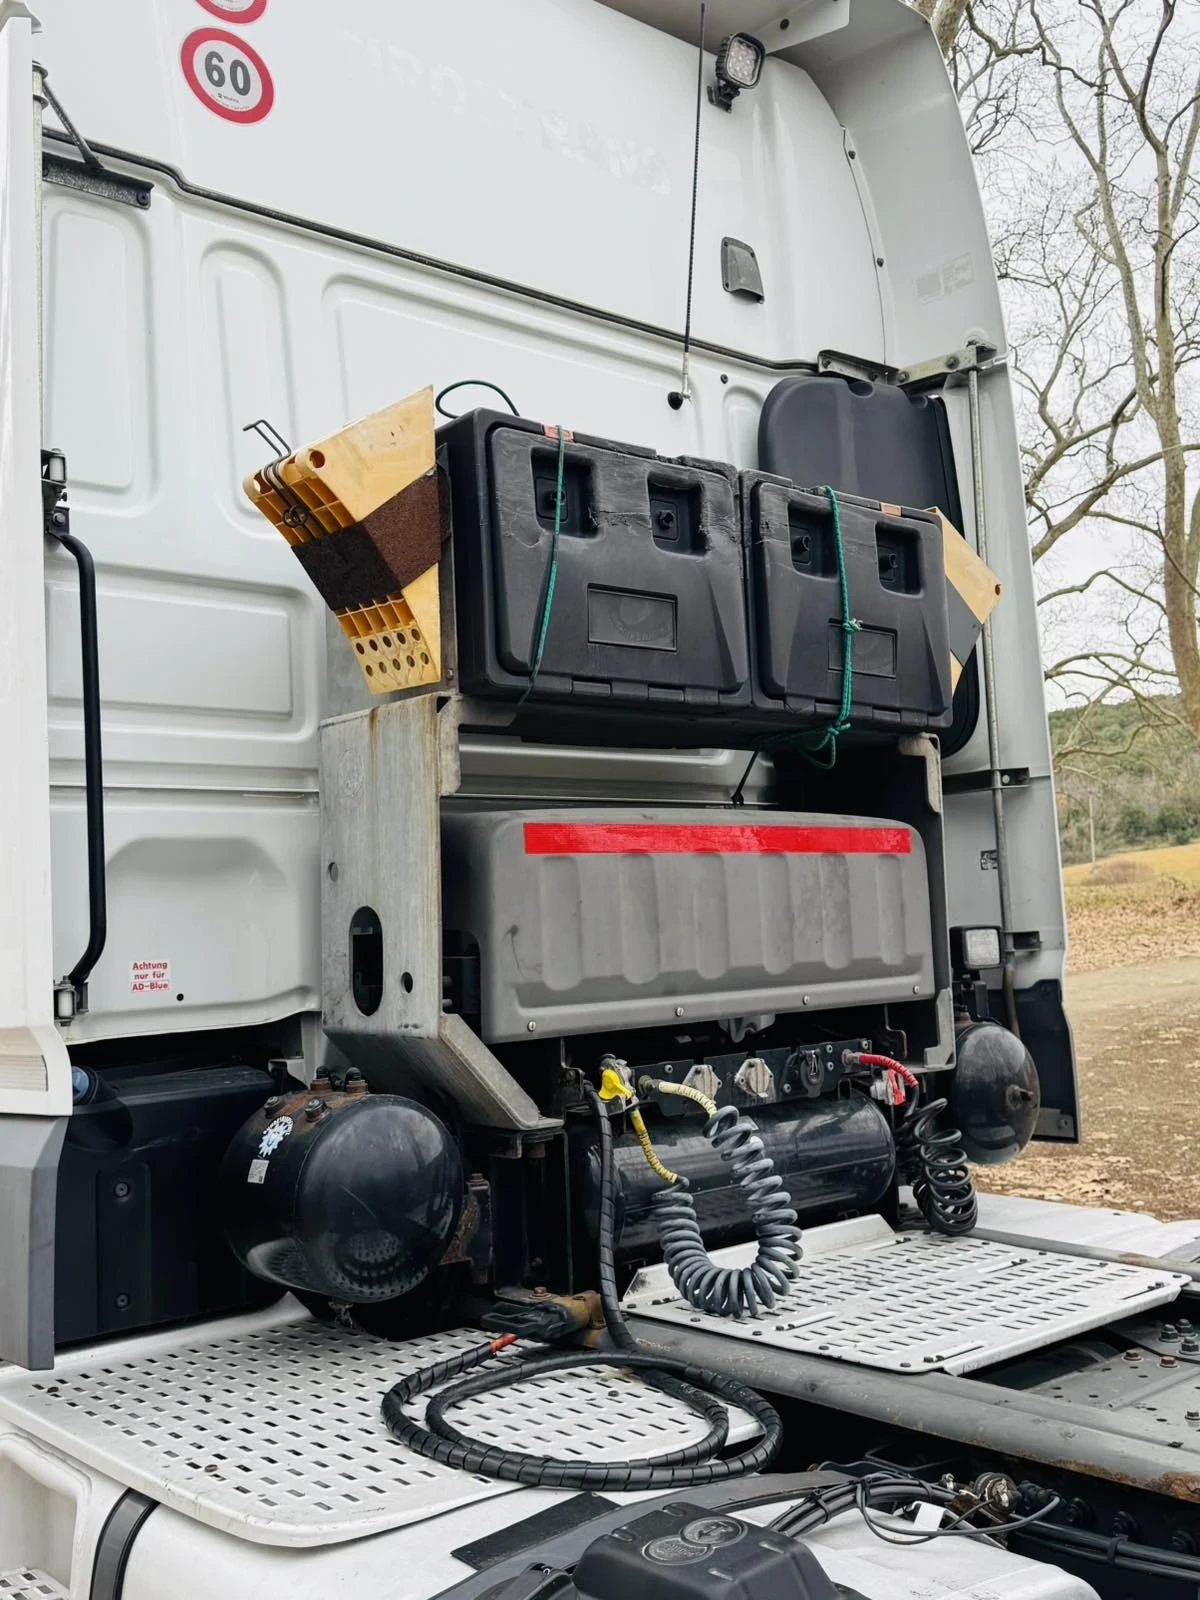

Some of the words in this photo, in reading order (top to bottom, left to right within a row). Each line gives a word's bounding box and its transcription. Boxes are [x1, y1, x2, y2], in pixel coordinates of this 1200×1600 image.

[205, 50, 251, 96] 60
[132, 961, 168, 970] Achtung
[132, 982, 168, 991] AD-Blue
